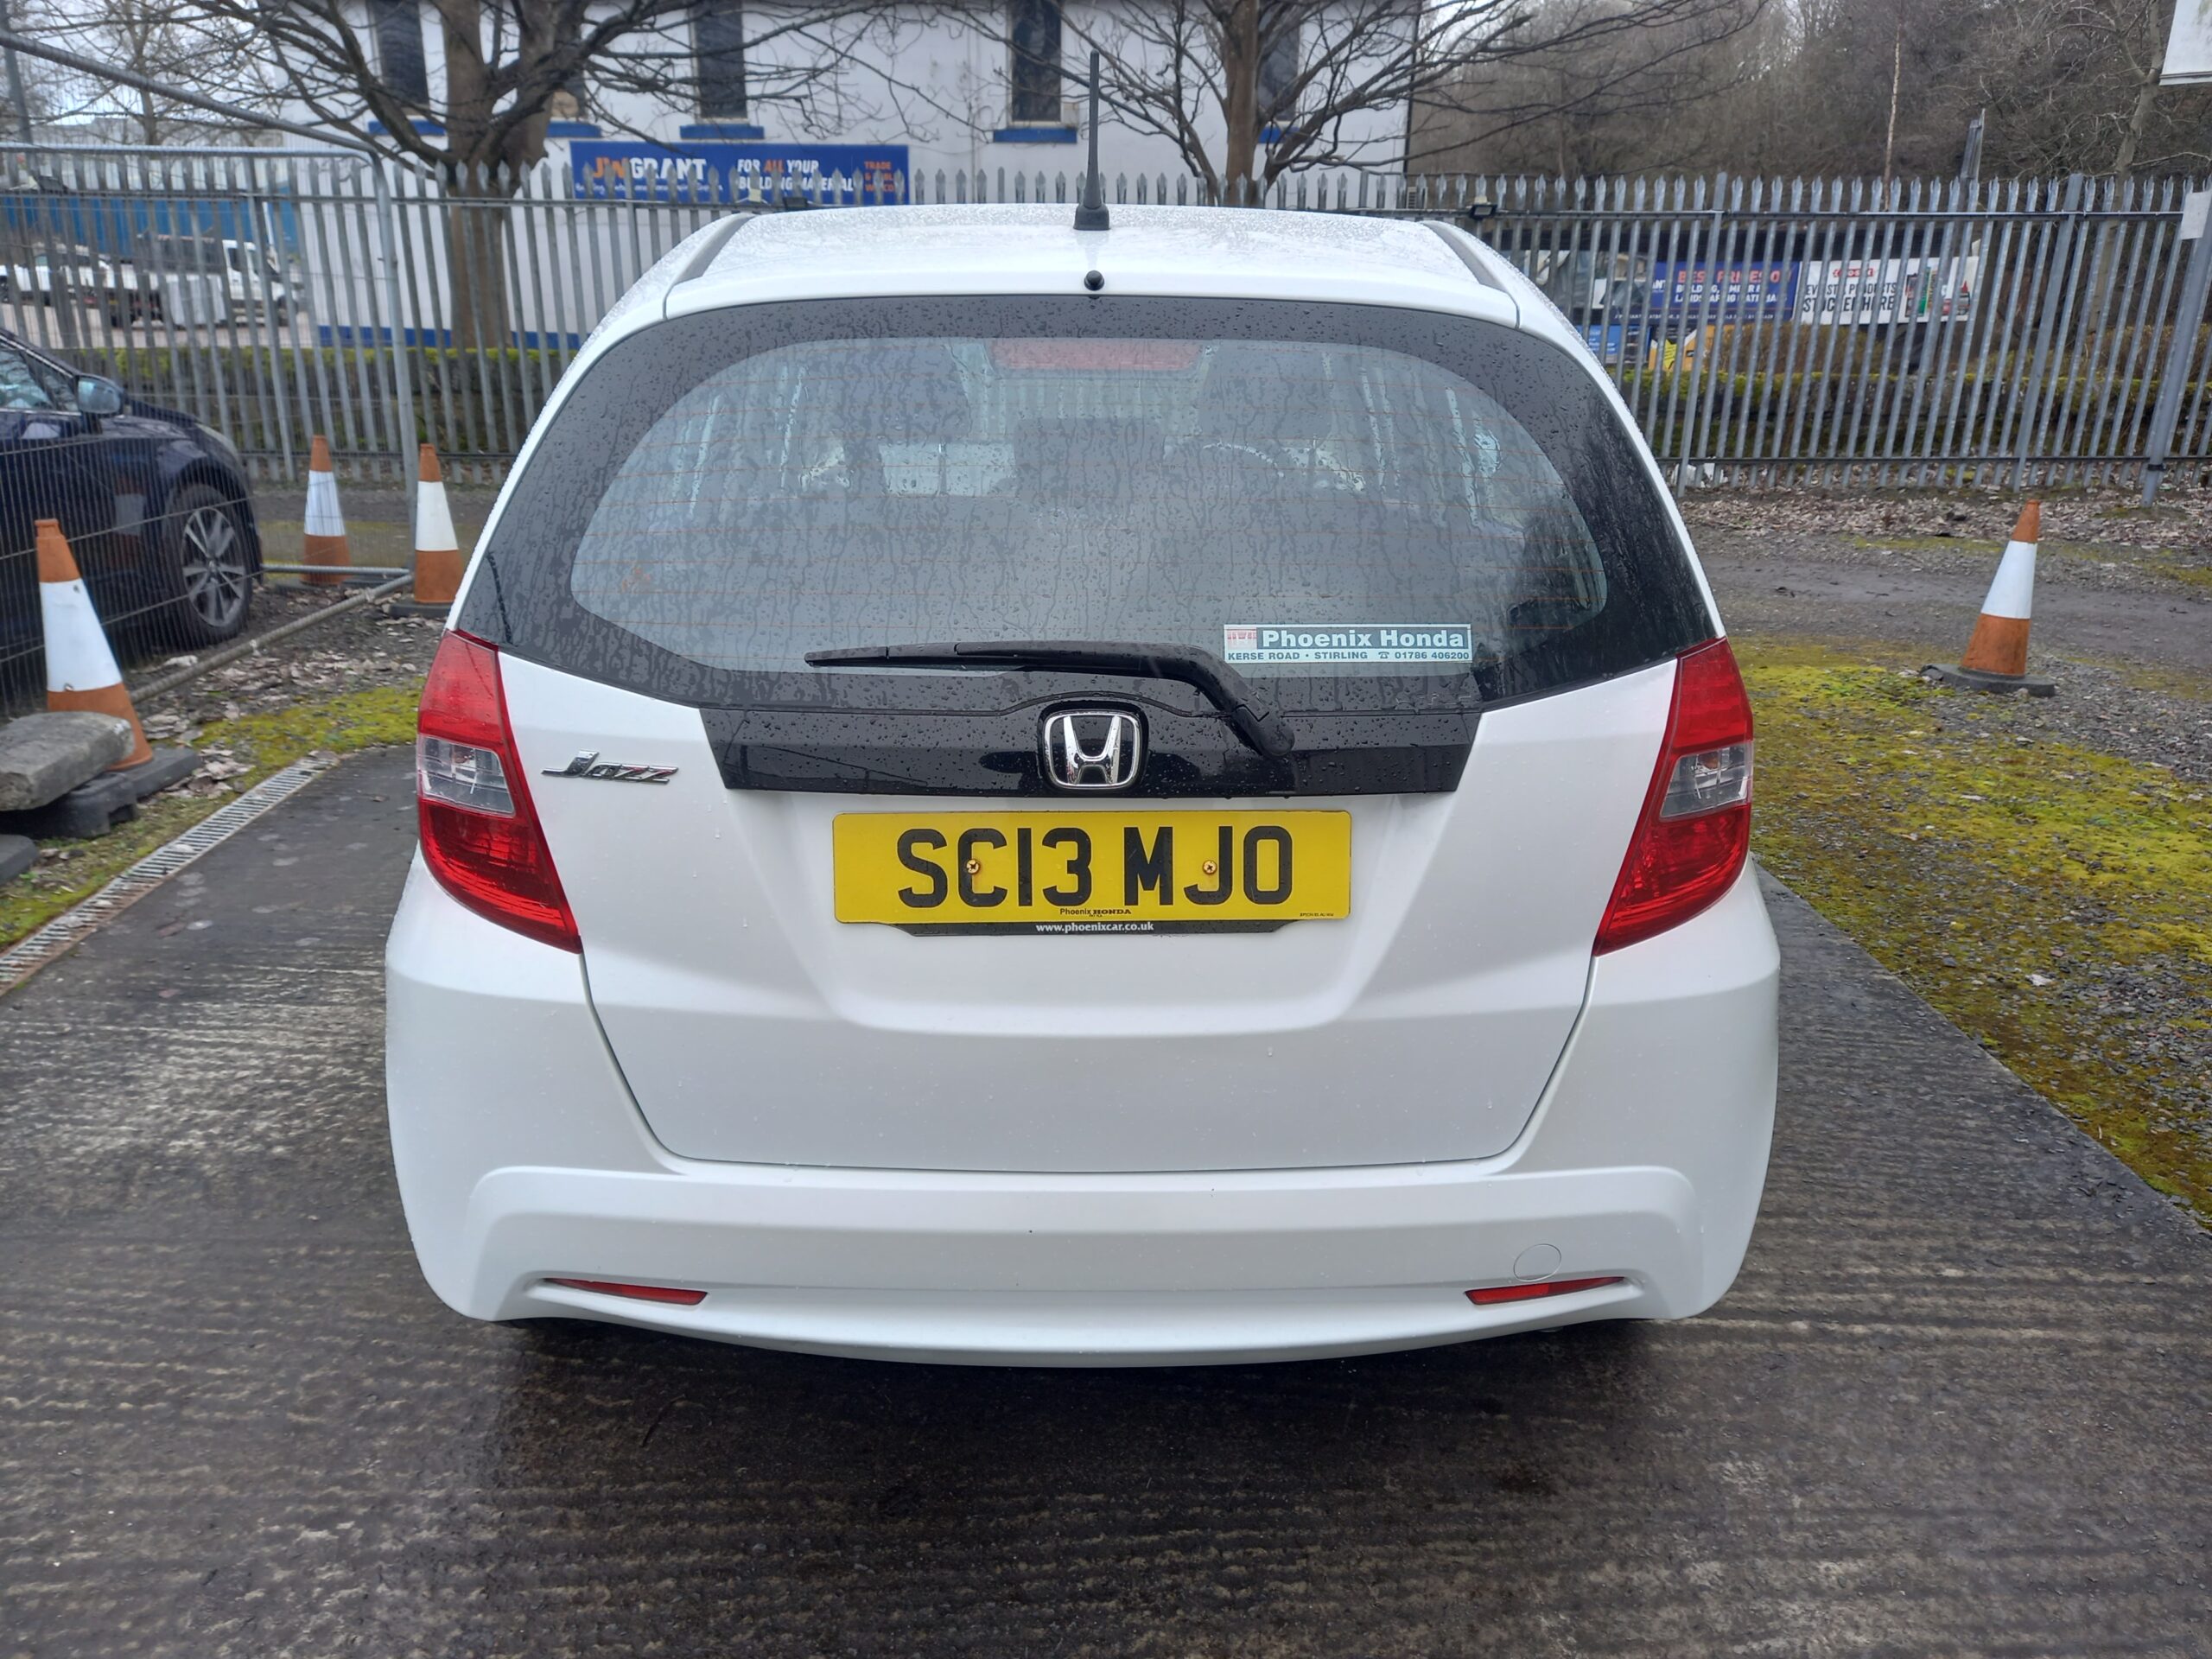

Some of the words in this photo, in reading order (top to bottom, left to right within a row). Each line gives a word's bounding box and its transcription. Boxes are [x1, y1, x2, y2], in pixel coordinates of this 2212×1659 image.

[629, 157, 707, 180] GRANT
[737, 158, 760, 173] FOR
[786, 159, 819, 174] YOUR
[739, 175, 793, 190] BLDG
[1262, 630, 1371, 647] Phoenix
[1380, 629, 1464, 647] Honda
[1268, 652, 1300, 660] ROAD
[1314, 651, 1368, 659] STIRLING
[541, 749, 679, 785] Jazz
[897, 827, 1093, 908] SC13
[1123, 825, 1294, 906] MJO
[1036, 922, 1154, 934] www.phoenixcar.co.uk
